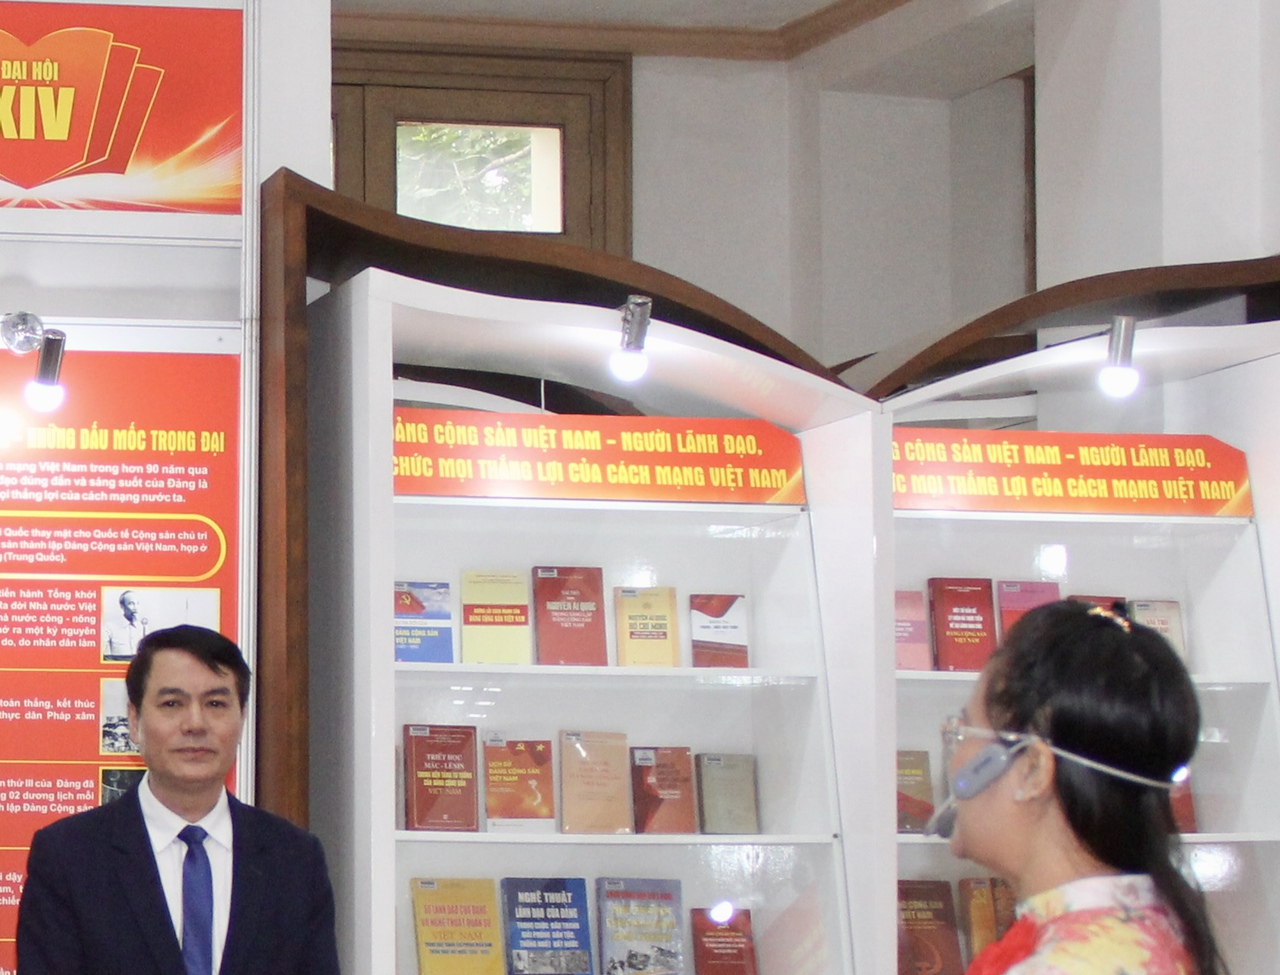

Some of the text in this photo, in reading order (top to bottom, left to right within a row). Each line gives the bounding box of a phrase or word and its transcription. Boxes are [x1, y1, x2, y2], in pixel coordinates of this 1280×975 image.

[0, 58, 59, 84] ĐẠI HỘI
[80, 421, 108, 450] DẤU
[113, 422, 146, 450] MỐC
[151, 430, 195, 455] TRỌNG
[201, 432, 224, 456] ĐẠI
[394, 416, 428, 443] ẢNG
[434, 421, 479, 448] CỘNG
[484, 421, 517, 447] SẢN
[522, 425, 556, 452] VIỆT
[562, 430, 601, 450] NAM
[621, 429, 672, 452] NGƯỜI
[678, 430, 718, 453] LÃNH
[723, 434, 762, 458] ĐẠO,
[905, 439, 947, 465] CỘNG
[951, 438, 983, 462] SẢN
[986, 441, 1019, 467] VIỆT
[1024, 445, 1062, 464] NAM
[1078, 444, 1127, 466] NGƯỜI
[1130, 445, 1170, 466] LÃNH
[1174, 448, 1211, 471] ĐẠO,
[438, 458, 473, 482] MỌI
[478, 455, 533, 481] THẮNG
[538, 461, 564, 485] LỢI
[569, 457, 602, 483] CỦA
[607, 461, 651, 484] CÁCH
[655, 467, 705, 489] MẠNG
[709, 464, 743, 491] VIỆT
[749, 469, 788, 488] NAM
[911, 475, 944, 497] MỌI
[947, 470, 998, 495] THẮNG
[1002, 476, 1028, 500] LỢI
[1032, 472, 1063, 497] CỦA
[1067, 475, 1108, 498] CÁCH
[1112, 479, 1159, 502] MẠNG
[1162, 477, 1194, 502] VIỆT
[1199, 481, 1235, 499] NAM
[0, 697, 20, 708] toàn
[24, 696, 53, 710] thắng,
[57, 696, 71, 708] kết
[74, 698, 95, 708] thúc
[25, 710, 42, 720] dân
[47, 710, 71, 723] Pháp
[76, 711, 95, 721] xâm
